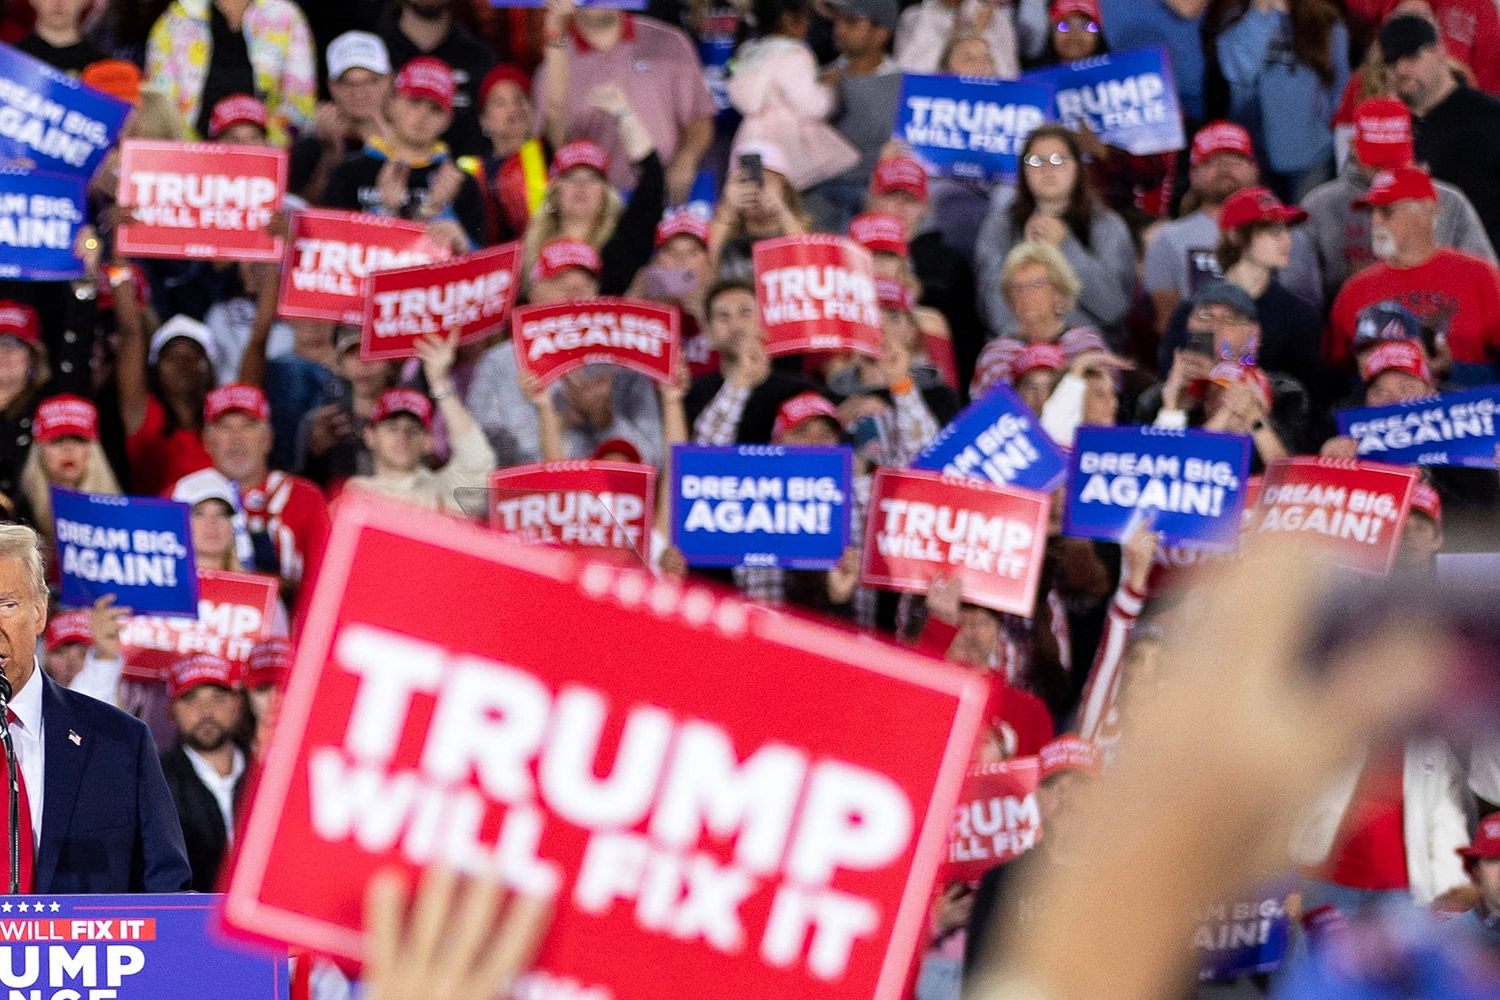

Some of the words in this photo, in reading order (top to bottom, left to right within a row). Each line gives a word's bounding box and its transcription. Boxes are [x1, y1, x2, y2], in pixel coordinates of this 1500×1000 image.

[1058, 73, 1165, 118] RUMP
[908, 96, 1043, 133] TRUMP
[129, 172, 276, 208] TRUMP
[30, 197, 82, 222] BIG,
[199, 206, 243, 229] FIX
[246, 206, 276, 230] IT
[292, 268, 359, 296] WILL
[376, 270, 512, 318] TRUMP
[372, 315, 442, 338] WILL
[522, 312, 617, 340] DREAM
[761, 300, 822, 326] WILL
[527, 330, 662, 361] AGAIN!
[1350, 408, 1444, 438] DREAM
[1357, 412, 1496, 455] AGAIN!
[982, 433, 1040, 483] IN!
[1080, 452, 1179, 480] DREAM
[1183, 457, 1238, 491] BIG,
[682, 476, 783, 500] DREAM
[786, 477, 844, 505] BIG,
[1080, 476, 1225, 517] AGAIN!
[1265, 483, 1348, 506] DREAM
[1350, 489, 1398, 520] BIG,
[497, 494, 643, 531] TRUMP
[683, 501, 830, 535] AGAIN!
[881, 499, 1033, 551] TRUMP
[1259, 506, 1384, 545] AGAIN!
[56, 518, 131, 551] DREAM
[133, 530, 186, 559] BIG,
[63, 546, 178, 588] AGAIN!
[877, 534, 945, 563] WILL
[947, 546, 991, 570] FIX
[994, 556, 1027, 582] IT
[334, 621, 917, 890] TRUMP
[953, 793, 1040, 838] RUM
[305, 744, 566, 900] WILL
[572, 829, 757, 953] FIX
[760, 882, 882, 981] IT
[0, 920, 64, 940] WILL
[71, 920, 113, 940] FIX
[119, 920, 145, 940] IT
